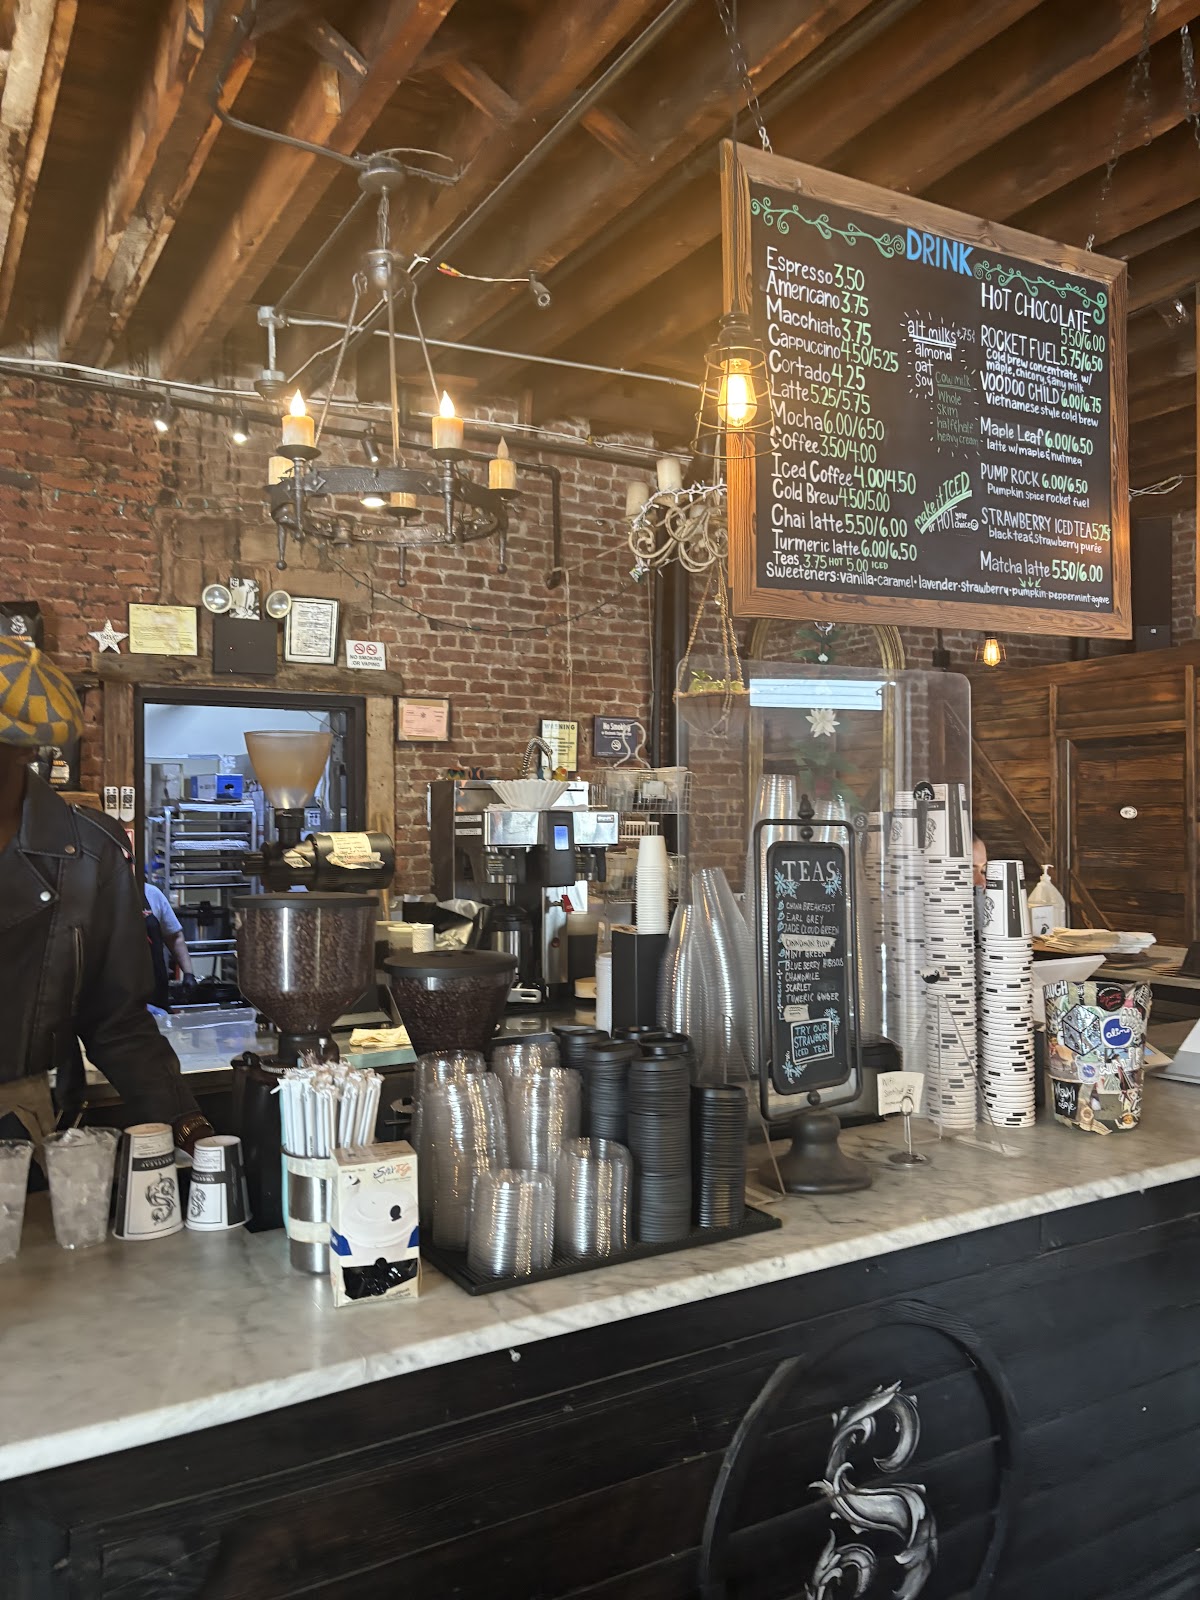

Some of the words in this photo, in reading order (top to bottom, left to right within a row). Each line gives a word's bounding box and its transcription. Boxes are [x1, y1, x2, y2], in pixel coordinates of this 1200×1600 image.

[906, 227, 974, 277] DRINK
[767, 246, 833, 285] Espresso
[834, 264, 865, 291] 3.50
[766, 270, 840, 309] Americano
[841, 291, 869, 317] 3.75
[981, 282, 1012, 311] HOT
[1014, 292, 1092, 333] CHOCOLATE
[766, 295, 842, 338] Macchiato
[841, 318, 872, 346] 3.75
[907, 319, 926, 338] alt
[928, 326, 957, 344] milks
[768, 323, 841, 359] Cappuccino
[841, 341, 899, 372] 4.50/5.25
[914, 342, 953, 362] almond
[981, 324, 1028, 356] ROCKET
[1029, 337, 1060, 365] FUEL
[1060, 346, 1104, 372] 5.75/6.50
[1060, 326, 1105, 353] 5.50/6.00
[769, 349, 831, 384] Cortado
[831, 363, 866, 391] 4.25
[914, 359, 934, 376] oat
[986, 360, 1015, 378] maple,
[1067, 381, 1085, 394] milk
[1007, 354, 1029, 369] brew
[1029, 361, 1078, 381] concentrate
[1080, 373, 1092, 386] w/
[771, 374, 810, 402] Latte
[810, 384, 871, 415] 5.25/5.75
[980, 371, 1025, 397] VOODOO
[1027, 383, 1060, 405] CHILD
[1060, 391, 1102, 414] 6.00/6.75
[772, 398, 824, 431] Mocha
[986, 391, 1040, 414] Vietnamese
[1040, 406, 1060, 420] style
[1061, 410, 1078, 424] cold
[1078, 413, 1099, 428] brew
[770, 425, 820, 454] Coffee
[819, 434, 877, 463] 3.50/4.00
[936, 429, 959, 448] heavy
[980, 416, 1015, 439] Maple
[1017, 423, 1044, 446] Leaf
[1044, 429, 1094, 455] 6.00/6.50
[986, 438, 1008, 452] latte
[1018, 446, 1046, 459] maple
[1051, 451, 1083, 467] nutmeg
[771, 452, 806, 480] Iced
[809, 460, 854, 487] Coffee
[853, 465, 917, 494] 4.00/4.50
[980, 462, 1009, 482] PUMP
[1010, 467, 1041, 488] ROCK
[1041, 473, 1088, 494] 6.00/6.50
[772, 478, 802, 502] Cold
[806, 483, 839, 506] Brew
[838, 487, 891, 512] 4.50/5.00
[914, 500, 936, 529] make
[942, 471, 970, 504] ICED
[987, 482, 1025, 500] Pumpkin
[1024, 490, 1045, 503] spice
[1045, 493, 1072, 506] rocket
[1072, 497, 1090, 508] fuel
[771, 503, 806, 529] Chai
[809, 510, 845, 534] latte
[844, 514, 908, 538] 5.50/6.00
[936, 505, 958, 532] HOT
[981, 507, 1052, 533] STRAWBERRY
[1054, 517, 1074, 536] ICED
[1073, 520, 1093, 539] TEA
[771, 528, 830, 553] Turmeric
[832, 539, 861, 556] latte
[860, 539, 918, 561] 6.00/6.50
[988, 525, 1013, 541] black
[1034, 533, 1080, 554] strawberry
[772, 551, 800, 566] Teas
[802, 554, 828, 569] 3.75
[828, 557, 844, 567] HOT
[846, 557, 869, 573] 5.00
[871, 560, 889, 570] ICED
[980, 550, 1022, 576] Matcha
[1024, 558, 1051, 578] latte
[1051, 559, 1104, 582] 5.50/6.00
[877, 575, 914, 589] caramel
[918, 574, 959, 592] lavender
[960, 580, 1009, 597] strawberry
[782, 860, 837, 882] TEAS
[786, 912, 804, 922] EARL
[805, 914, 824, 925] GREY
[802, 901, 836, 913] BREAKFAST
[783, 922, 800, 934] JADE
[800, 923, 820, 935] CLOUD
[820, 925, 839, 936] GREEN
[804, 950, 827, 959] GREEN
[784, 982, 812, 993] SCARLET
[794, 1025, 811, 1036] TRY
[813, 1022, 828, 1033] OUR
[794, 1047, 809, 1058] ICED
